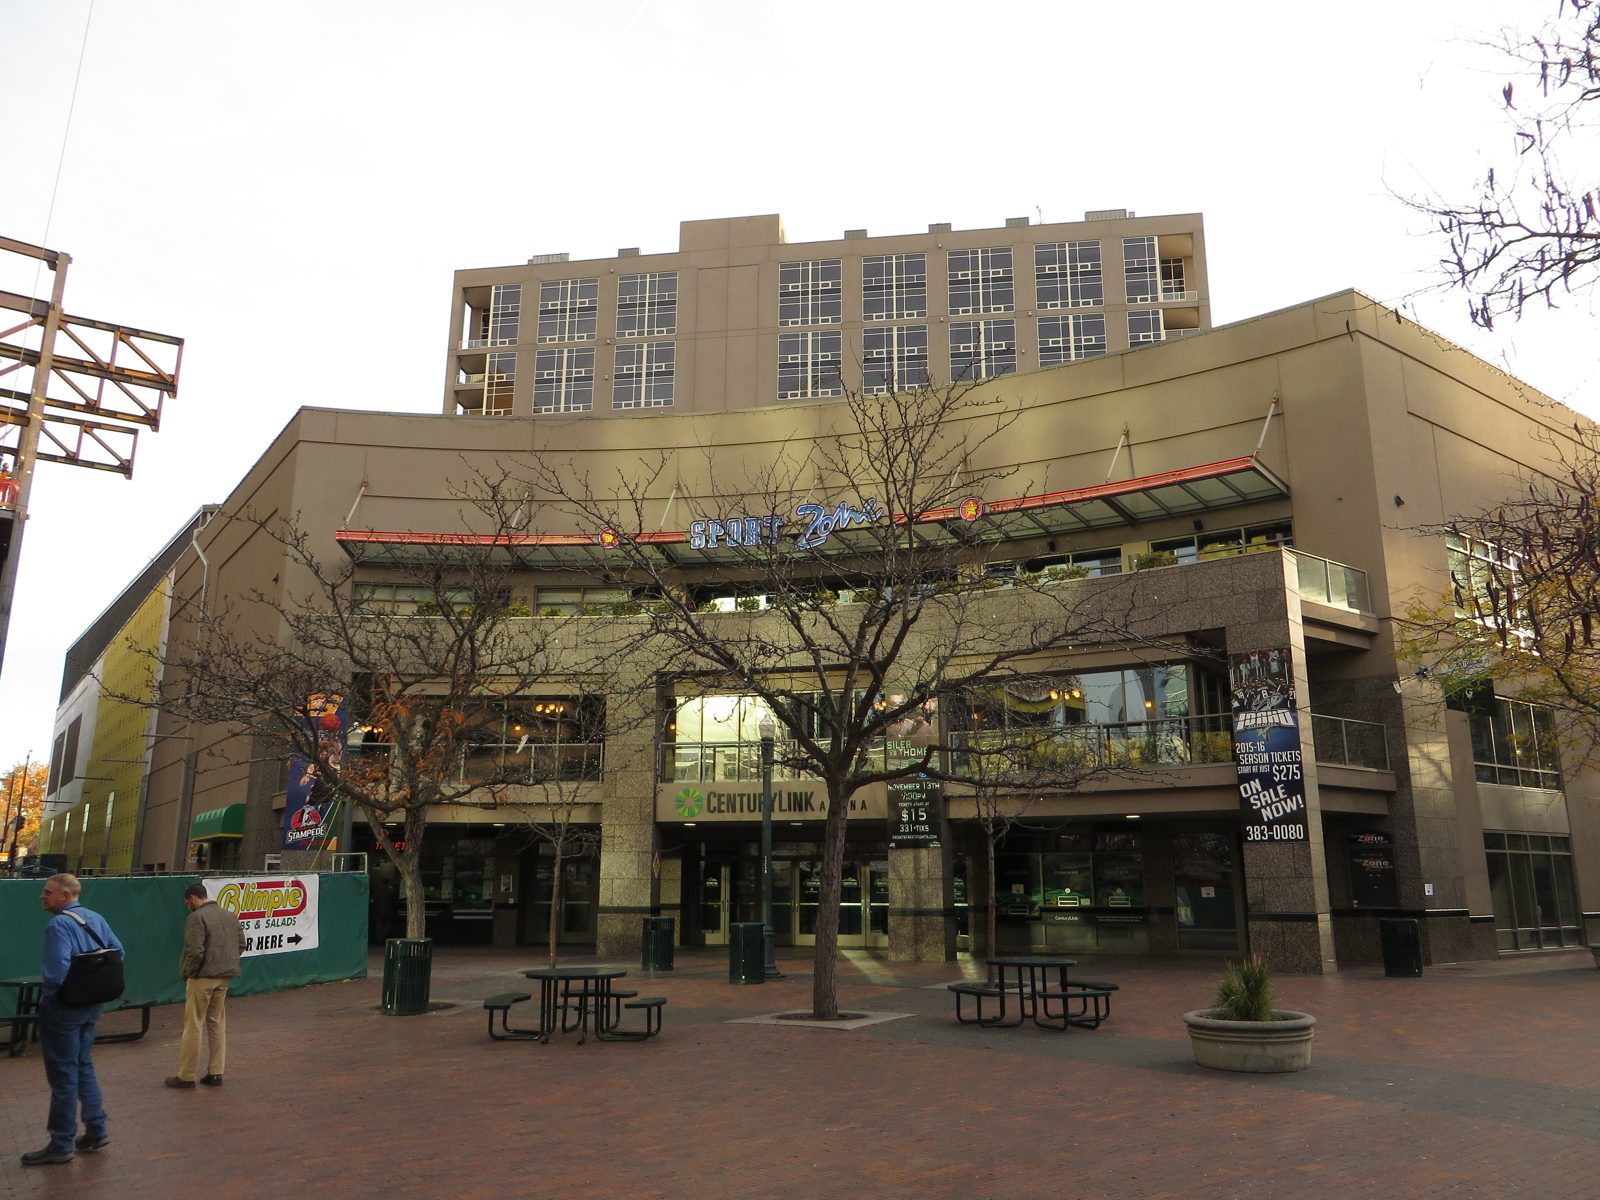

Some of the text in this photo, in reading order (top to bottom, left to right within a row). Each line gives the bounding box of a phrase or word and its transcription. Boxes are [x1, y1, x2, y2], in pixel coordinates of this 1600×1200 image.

[690, 515, 784, 549] SPORT
[1261, 689, 1269, 699] 8
[1236, 709, 1295, 731] IDAHO
[887, 740, 912, 749] SILER
[1236, 741, 1265, 754] 2015-16
[1240, 750, 1301, 765] SEASON TICKETS
[1272, 764, 1300, 782] $275
[887, 781, 940, 791] NOVEMBER 13TH
[1240, 778, 1262, 798] ON
[1250, 784, 1287, 810] SALE
[819, 800, 867, 812] ANA
[1260, 794, 1304, 822] NOW!
[901, 808, 927, 823] $15
[287, 826, 326, 842] STAMPEDE
[1246, 824, 1304, 841] 383-0080
[217, 880, 303, 918] Blimpie
[254, 920, 261, 930] &
[265, 917, 297, 929] SALADS
[256, 934, 284, 951] HERE
